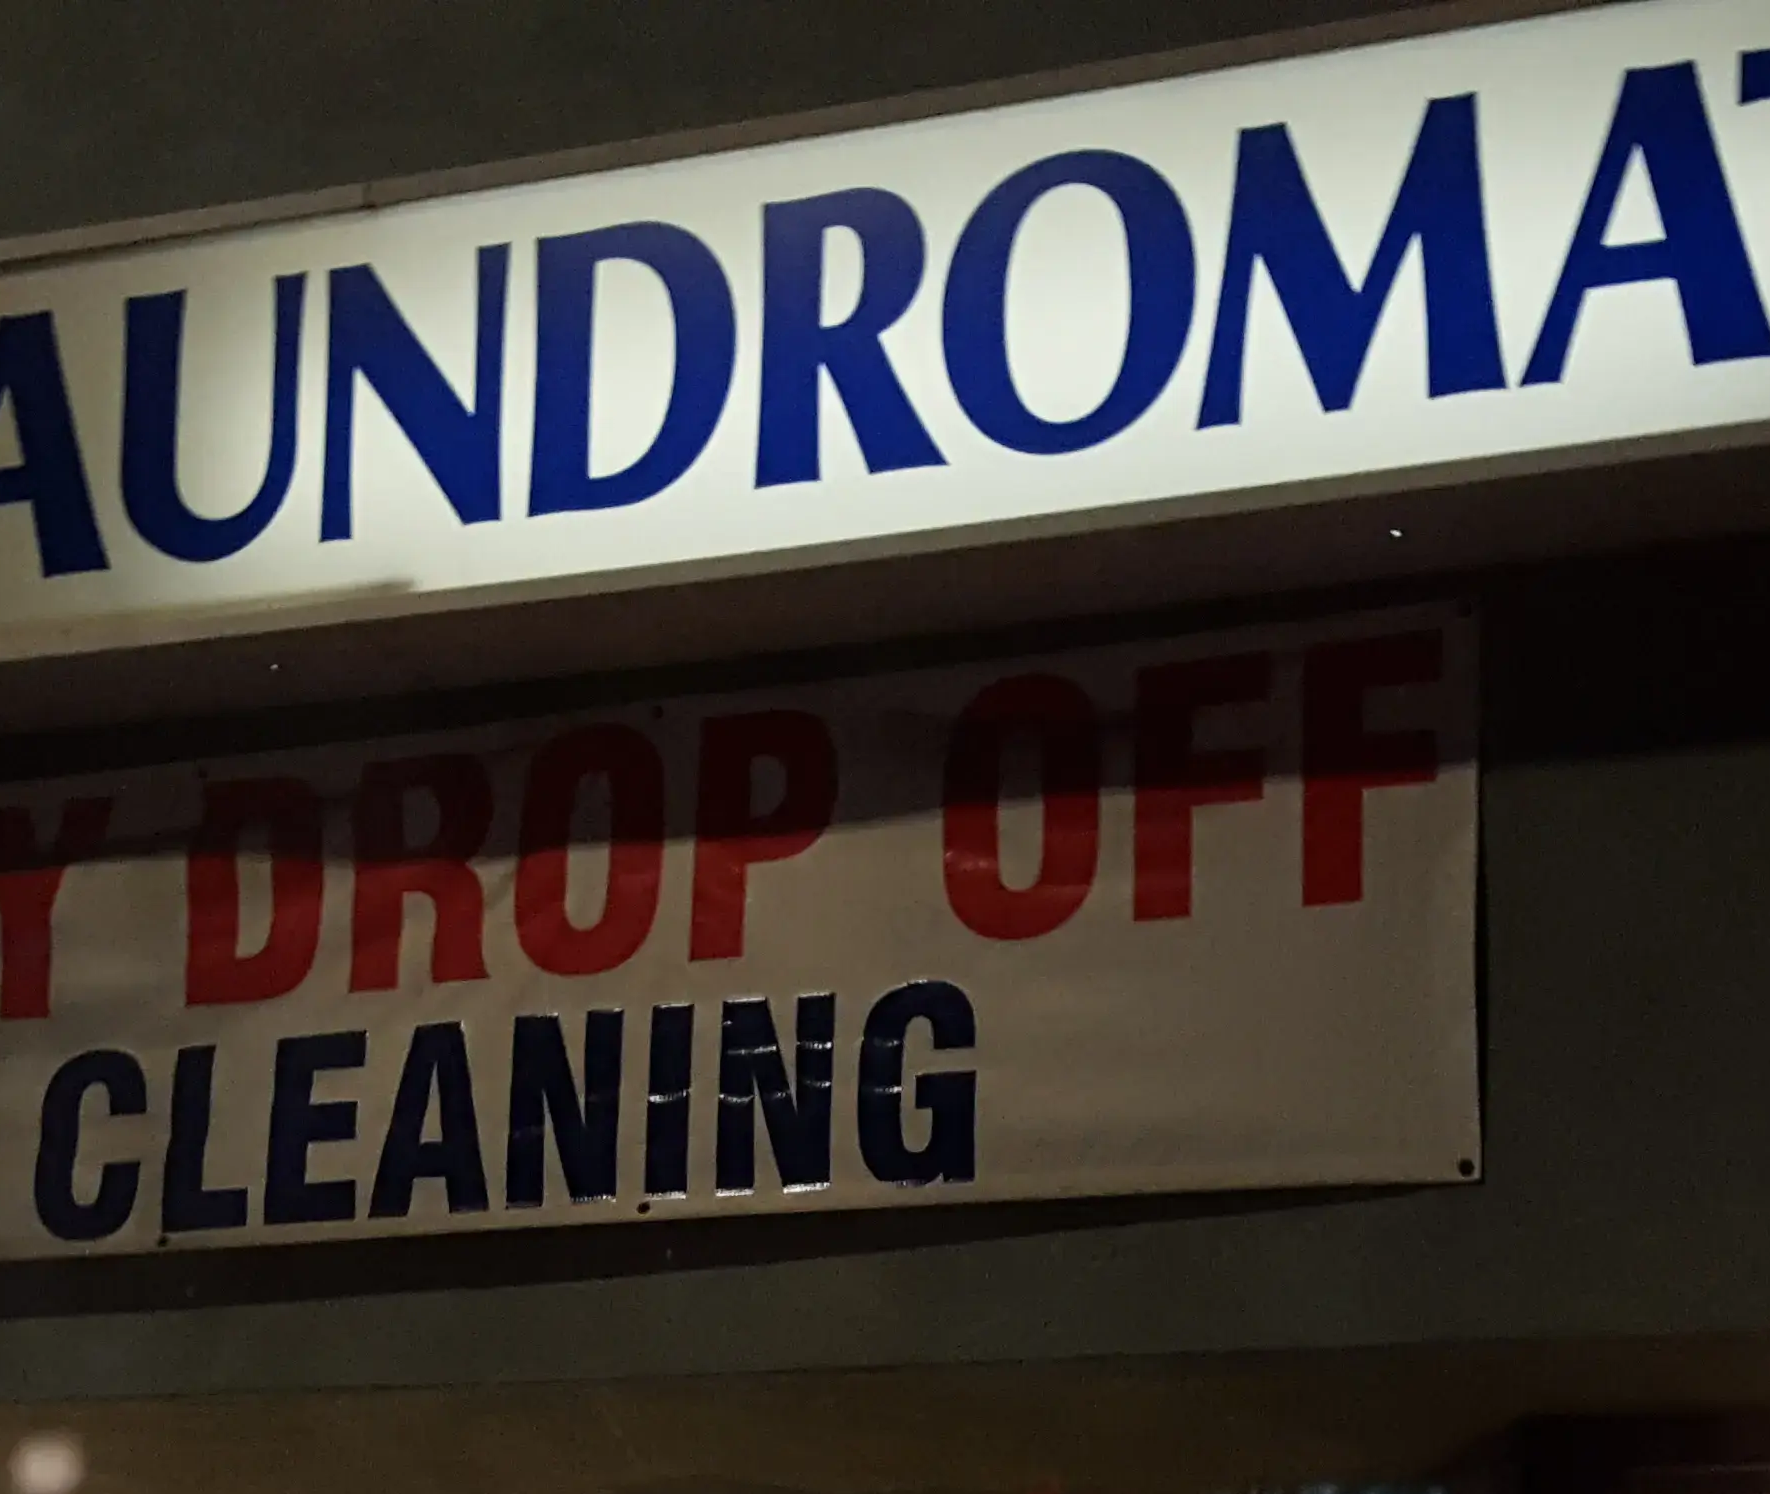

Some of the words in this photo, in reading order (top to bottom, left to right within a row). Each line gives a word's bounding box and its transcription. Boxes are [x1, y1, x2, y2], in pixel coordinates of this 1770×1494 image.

[181, 706, 841, 1009] DROP
[939, 628, 1445, 941] OFF
[34, 981, 979, 1244] CLEANING
